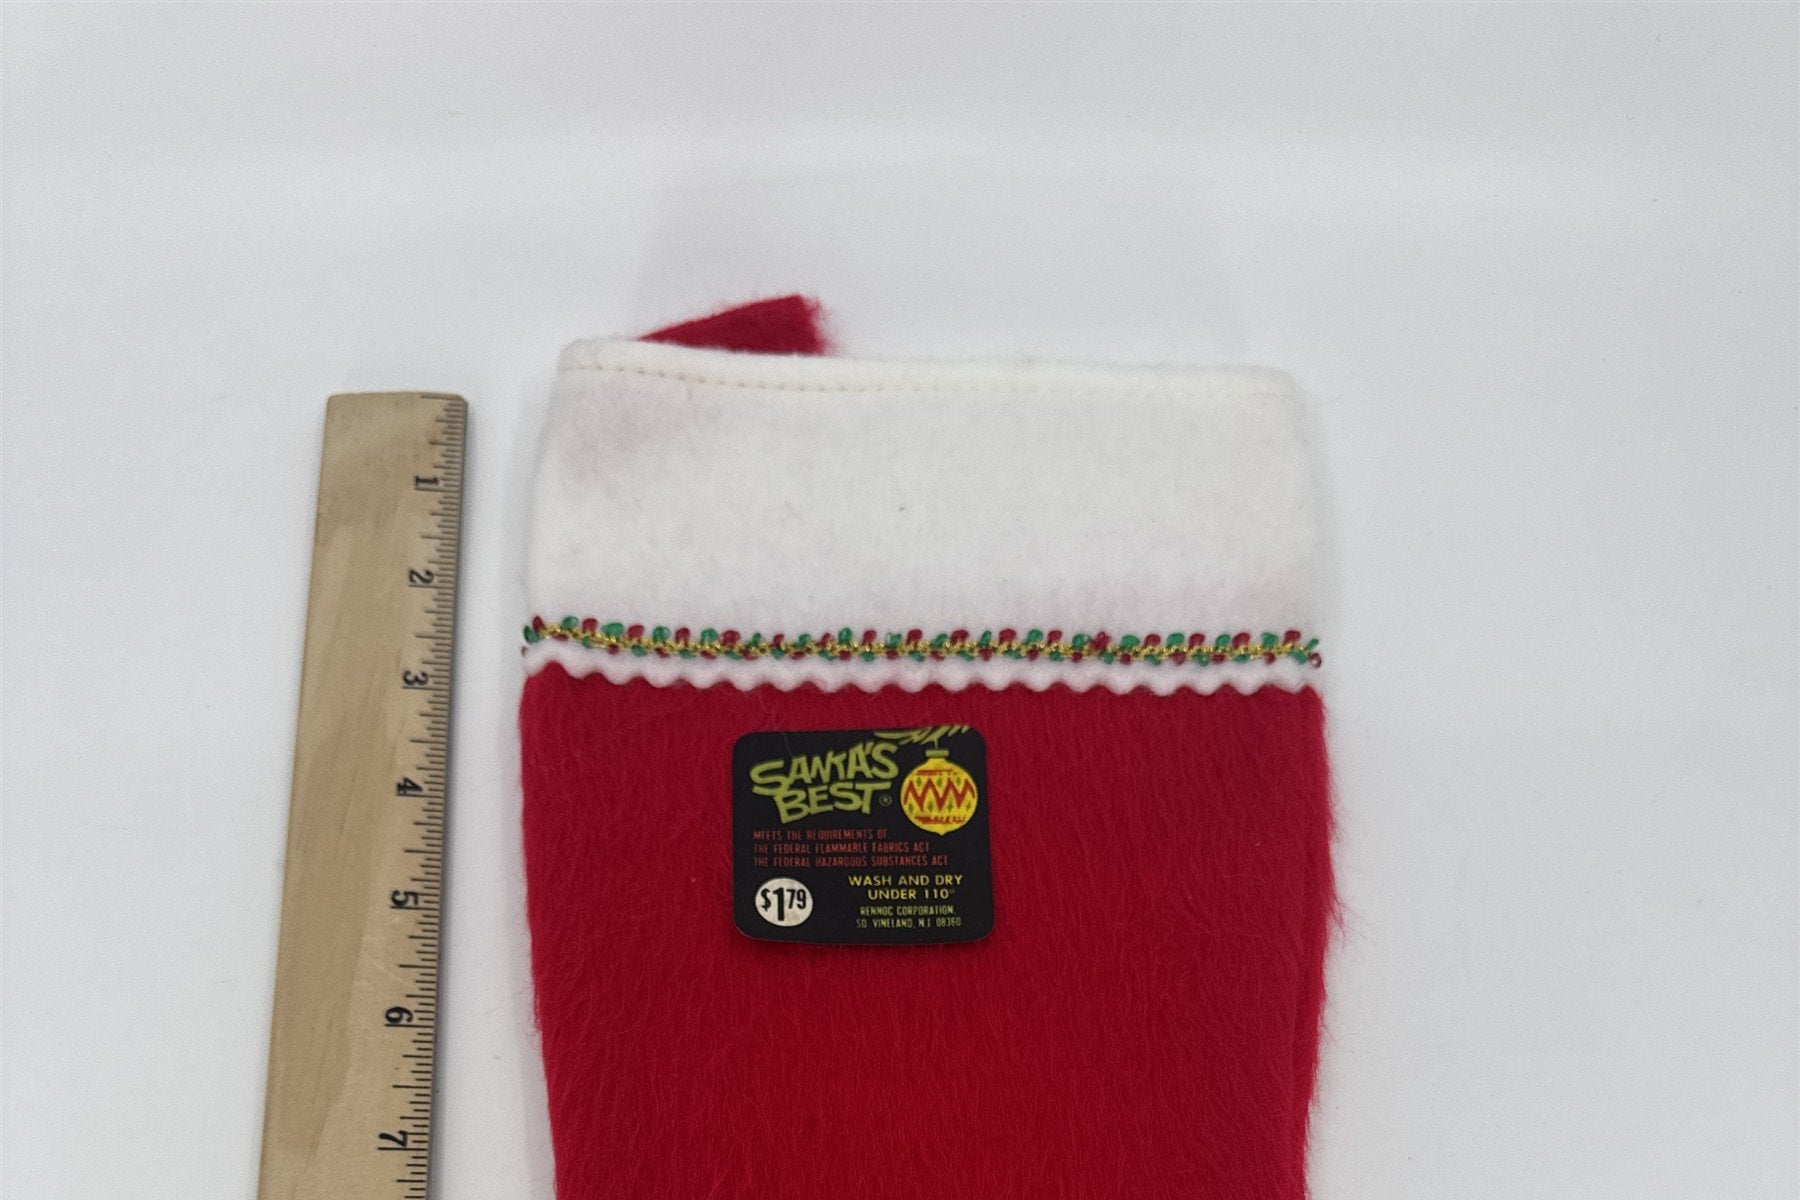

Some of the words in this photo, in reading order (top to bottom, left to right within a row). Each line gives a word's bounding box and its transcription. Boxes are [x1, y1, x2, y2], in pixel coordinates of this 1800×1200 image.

[414, 475, 439, 487] 1
[407, 569, 435, 585] 2
[402, 670, 430, 686] 3
[750, 741, 899, 796] SANTA'S
[396, 776, 424, 795] 4
[753, 830, 782, 840] MEETS
[806, 829, 873, 840] REQUIREMENTS
[877, 828, 888, 839] OF
[754, 843, 768, 854] THE
[774, 843, 810, 854] FEDERAL
[815, 842, 868, 853] FLAMMABLE
[872, 842, 909, 853] FABRICS
[913, 842, 930, 851] ACT
[754, 857, 768, 867] THE
[774, 857, 810, 867] FEDERAL
[815, 856, 868, 867] HAZARDOUS
[871, 855, 928, 867] SUBSTANCES
[932, 855, 949, 866] ACT
[848, 875, 892, 887] WASH
[898, 875, 930, 886] AND
[935, 874, 963, 885] DRY
[390, 890, 419, 907] 5
[867, 889, 917, 900] UNDER
[385, 1006, 414, 1025] 6
[378, 1130, 408, 1148] 7
